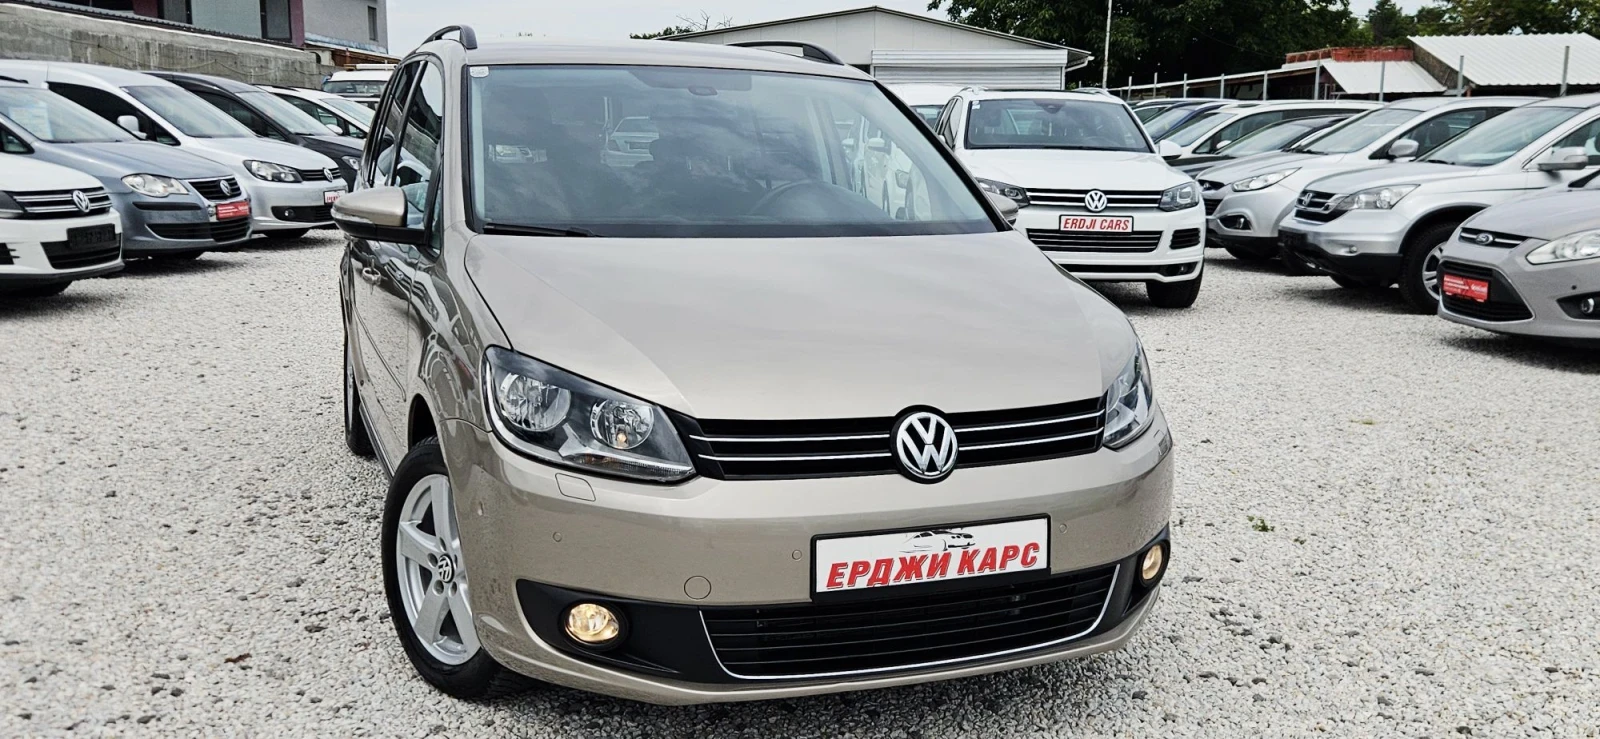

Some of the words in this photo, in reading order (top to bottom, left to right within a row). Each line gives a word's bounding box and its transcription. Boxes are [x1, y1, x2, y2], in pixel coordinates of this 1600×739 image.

[1085, 190, 1107, 212] VW
[1063, 218, 1097, 230] ERDJI
[1100, 219, 1130, 230] CARS
[896, 411, 958, 479] VW
[826, 552, 952, 589] ЕРДЖИ
[957, 542, 1040, 576] КАРС
